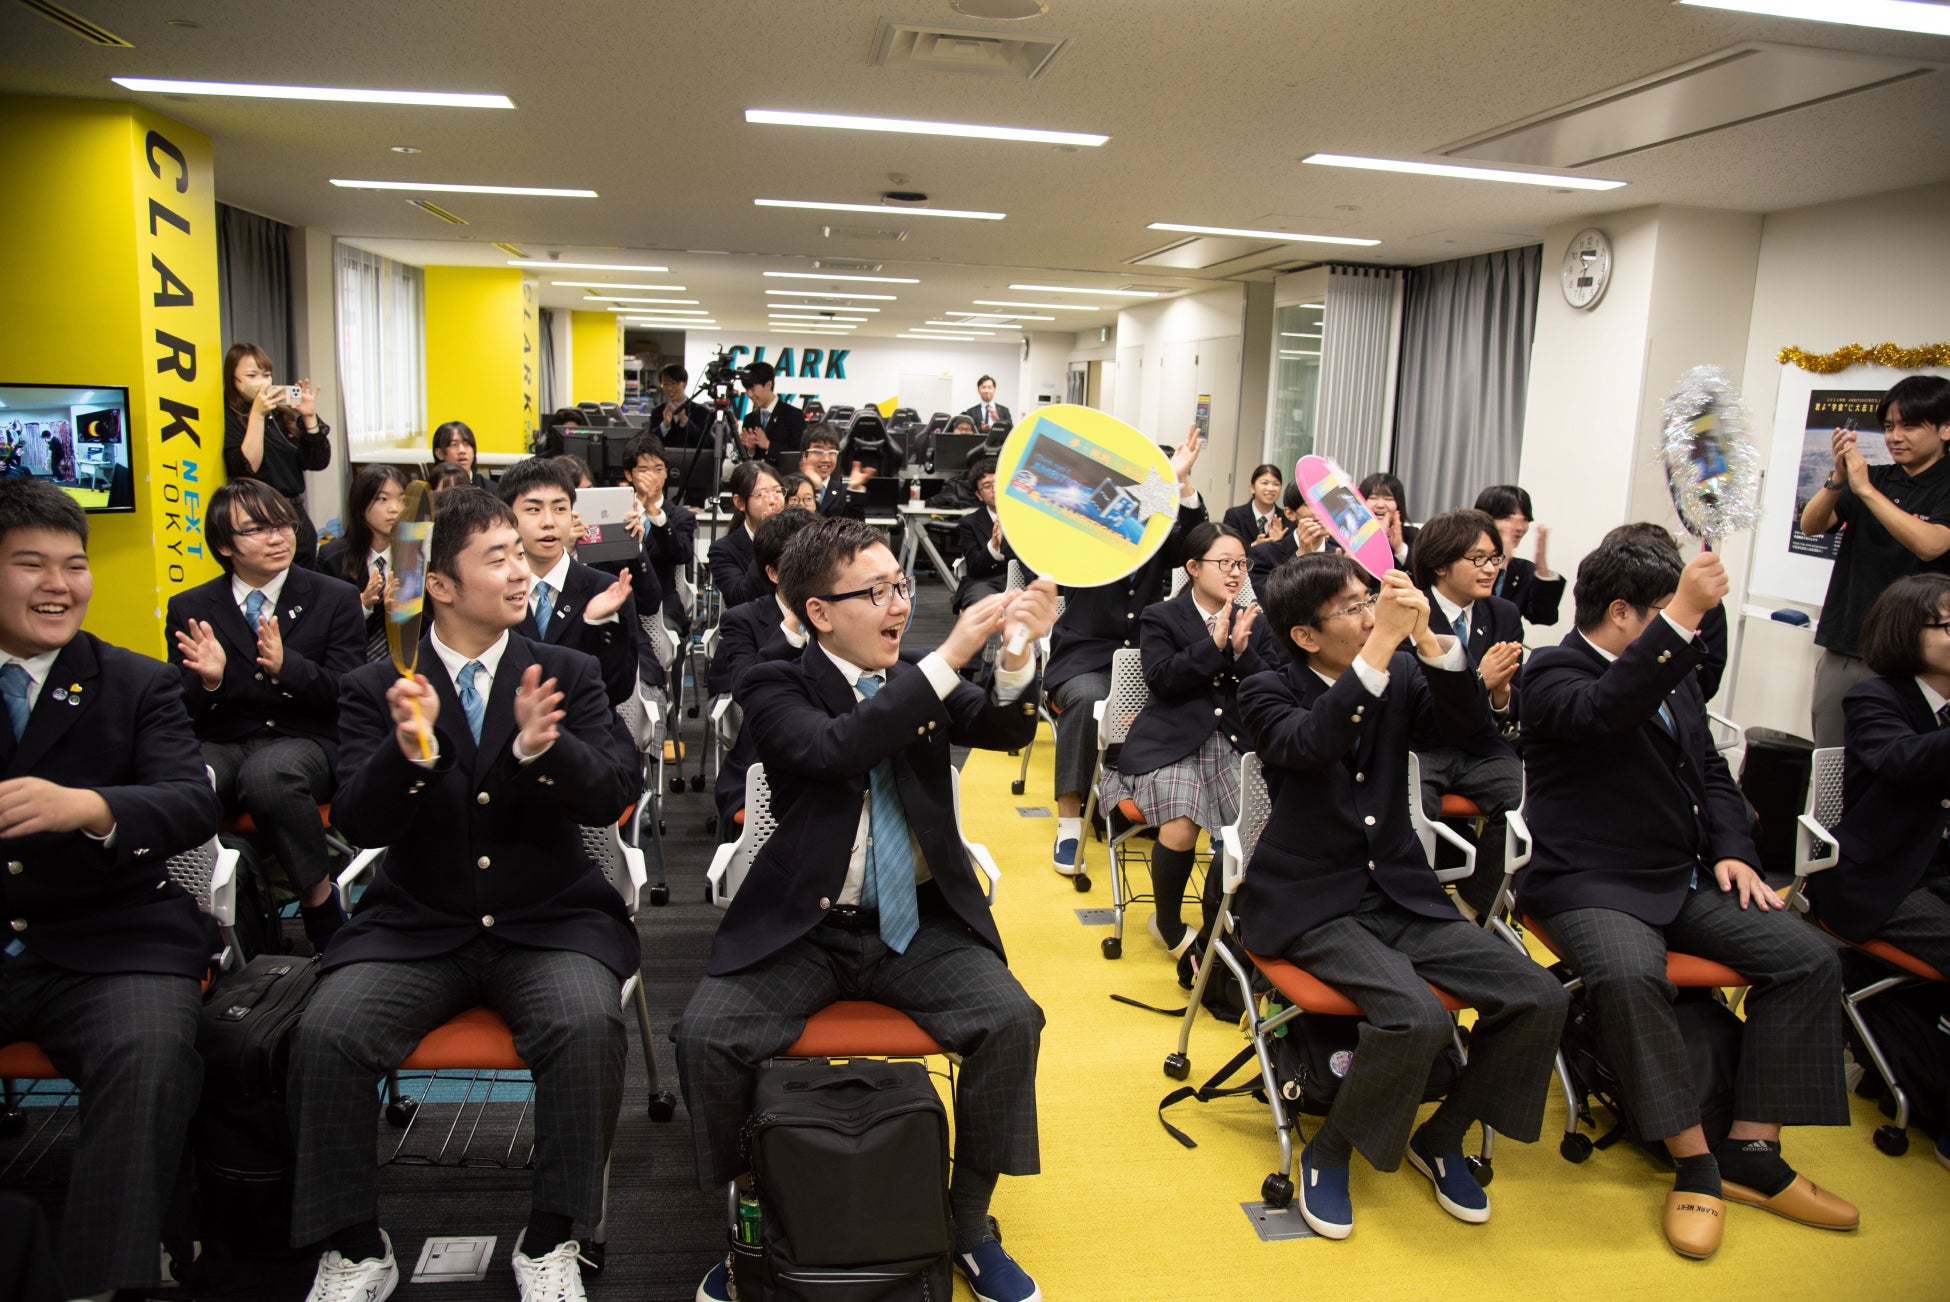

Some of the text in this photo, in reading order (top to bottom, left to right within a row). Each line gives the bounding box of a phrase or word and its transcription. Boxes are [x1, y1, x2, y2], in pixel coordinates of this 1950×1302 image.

[146, 130, 201, 449] CLARK
[162, 460, 184, 583] TOKYO
[182, 459, 203, 560] NEXT
[1677, 1203, 1719, 1217] CLARK NEXT
